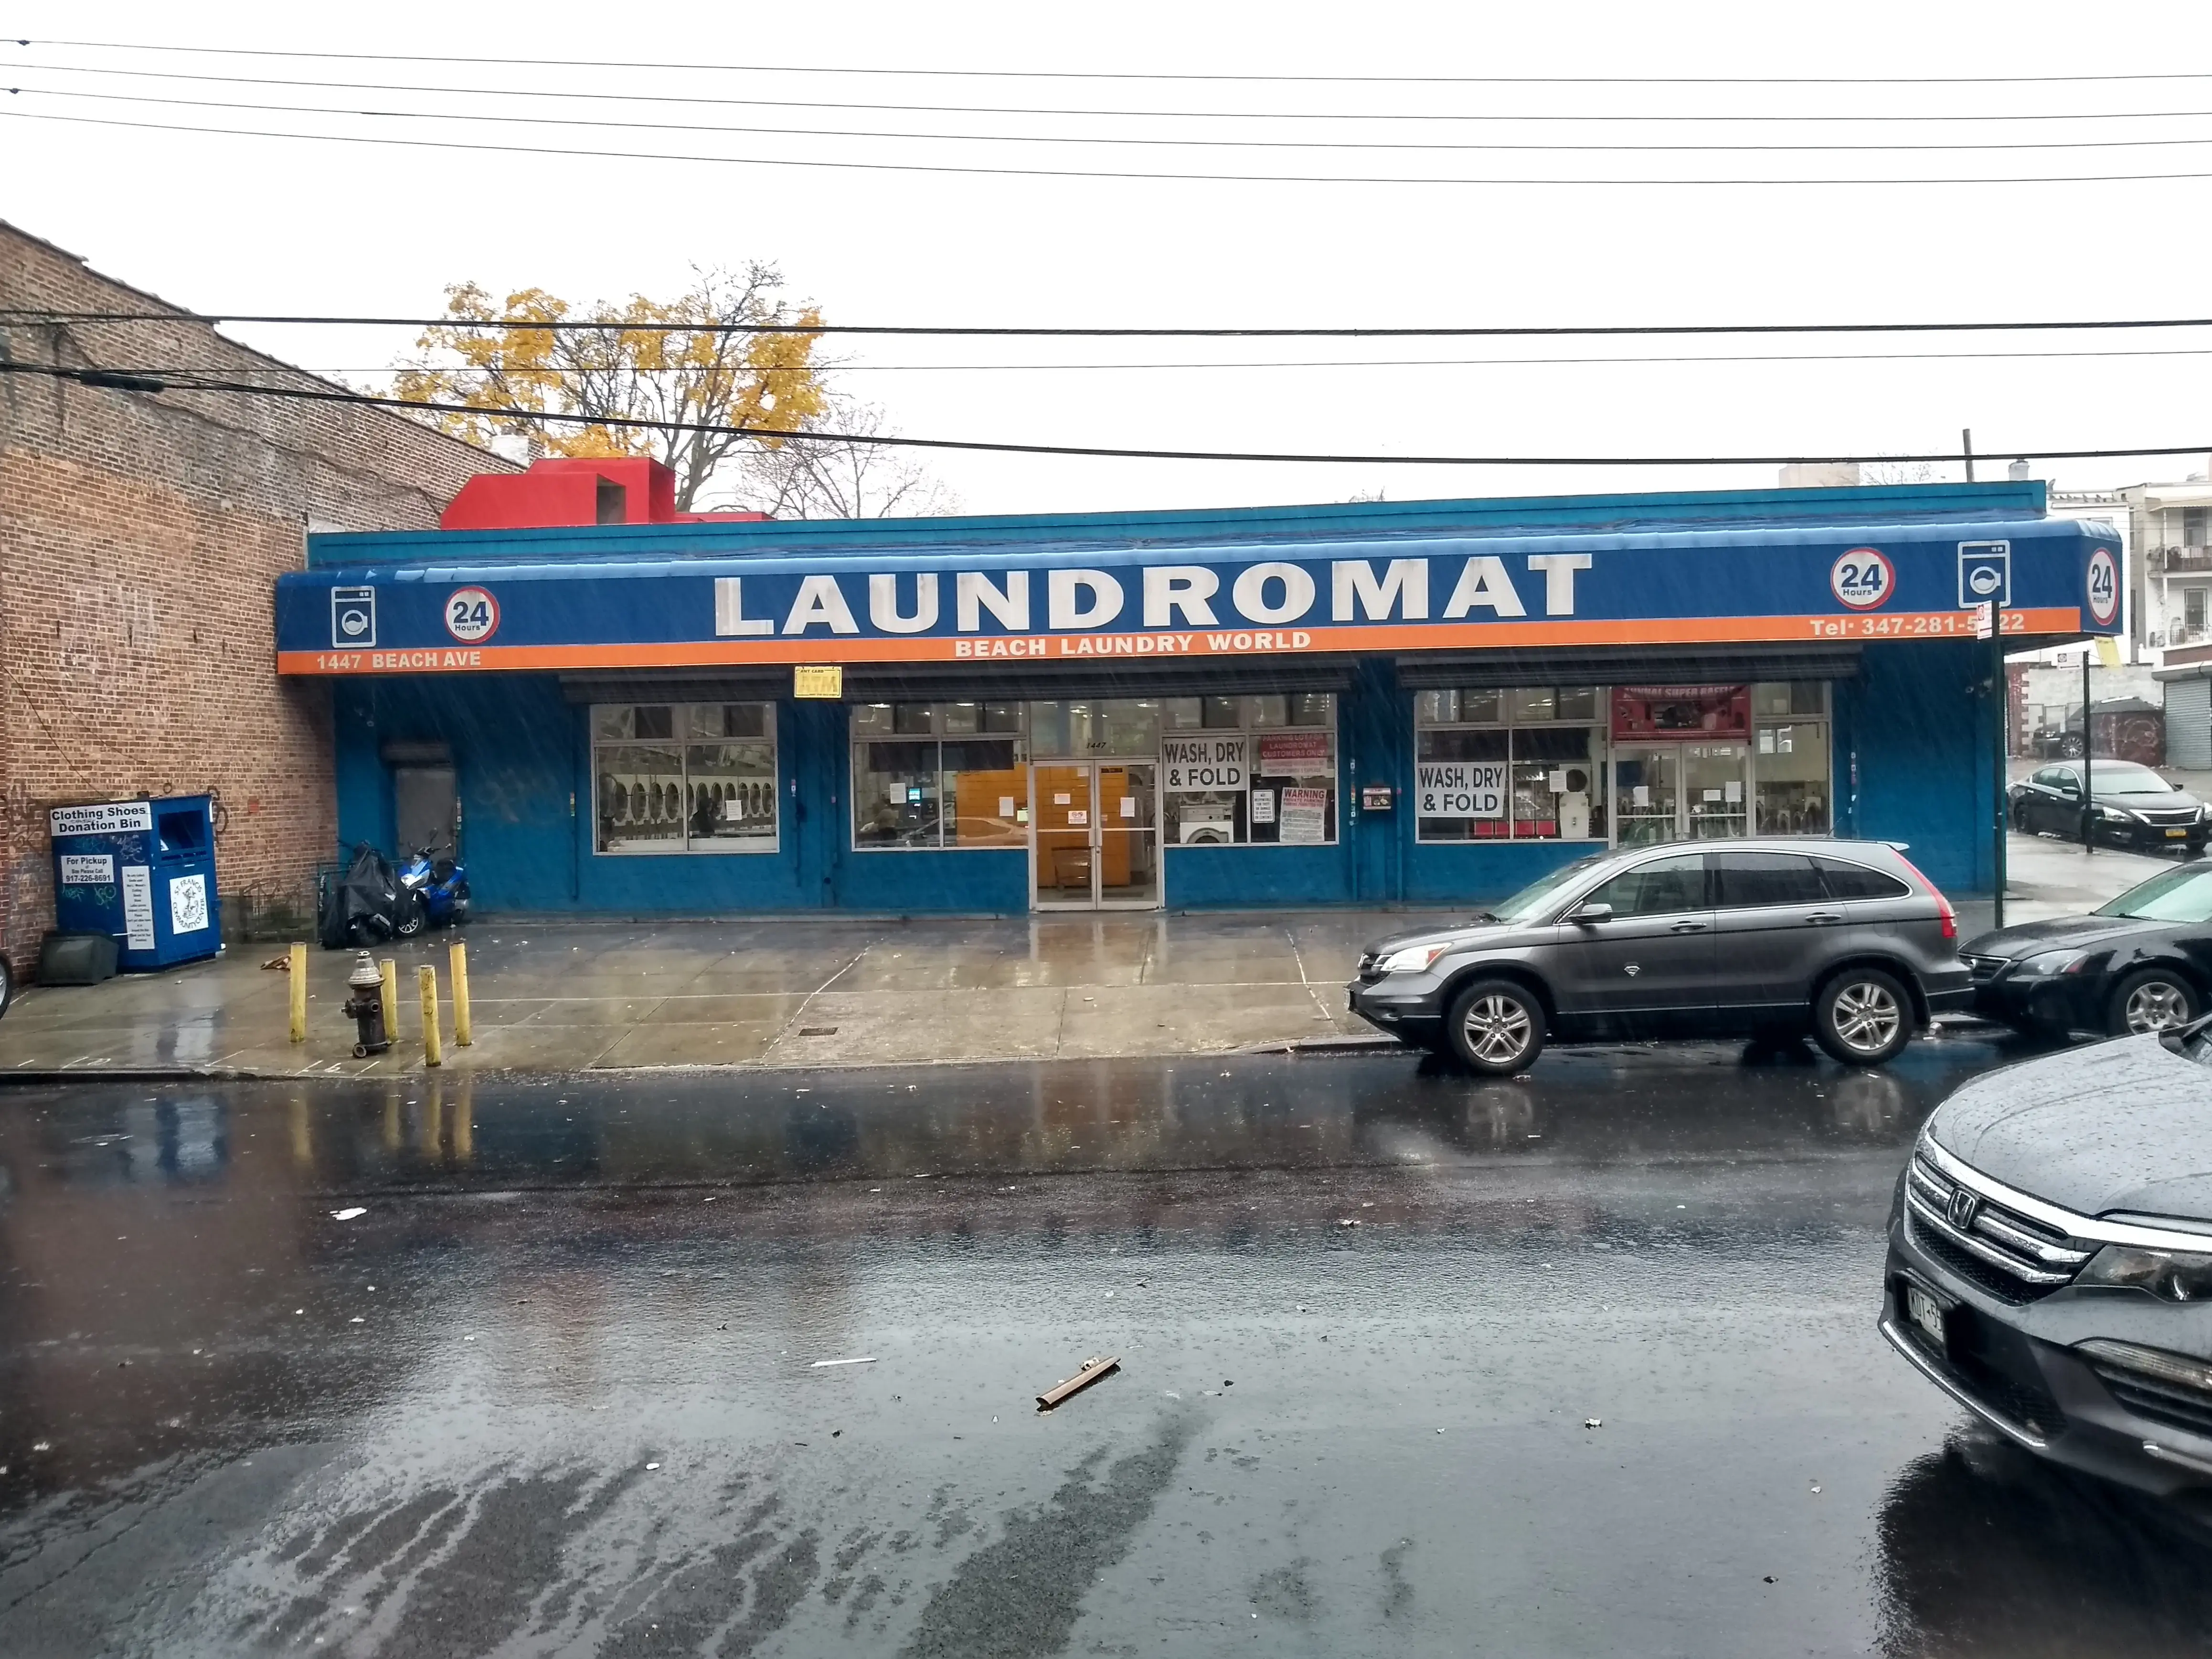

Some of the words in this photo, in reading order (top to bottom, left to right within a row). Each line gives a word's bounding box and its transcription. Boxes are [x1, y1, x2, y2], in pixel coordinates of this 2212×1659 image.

[1841, 564, 1882, 591] 24
[2092, 564, 2112, 598] 24
[714, 553, 1592, 636] LAUNDROMAT
[2093, 596, 2108, 604] Hours
[453, 601, 489, 626] 24
[1861, 614, 2025, 635] 347-281-522
[955, 638, 1046, 657] BEACH
[1061, 635, 1193, 655] LAUNDRY
[1206, 631, 1311, 650] WORLD
[318, 655, 362, 669] 1447
[372, 652, 437, 668] BEACH
[444, 651, 481, 666] AVE
[1165, 742, 1212, 765] WASH,
[1216, 742, 1244, 762] DRY
[1170, 769, 1181, 786] &
[1189, 768, 1240, 786] FOLD
[1419, 767, 1468, 791] WASH,
[1473, 767, 1503, 788] DRY
[1285, 789, 1324, 799] WARNING
[1424, 794, 1436, 811] &
[1444, 794, 1498, 811] FOLD
[52, 809, 103, 820] Clothing
[107, 807, 146, 816] Shoes
[59, 820, 115, 832] Donation
[120, 819, 141, 828] Bin
[81, 857, 107, 866] Pickup
[180, 879, 202, 893] FRANCIS
[173, 902, 197, 929] COMMUNITY
[195, 898, 205, 924] CENTER
